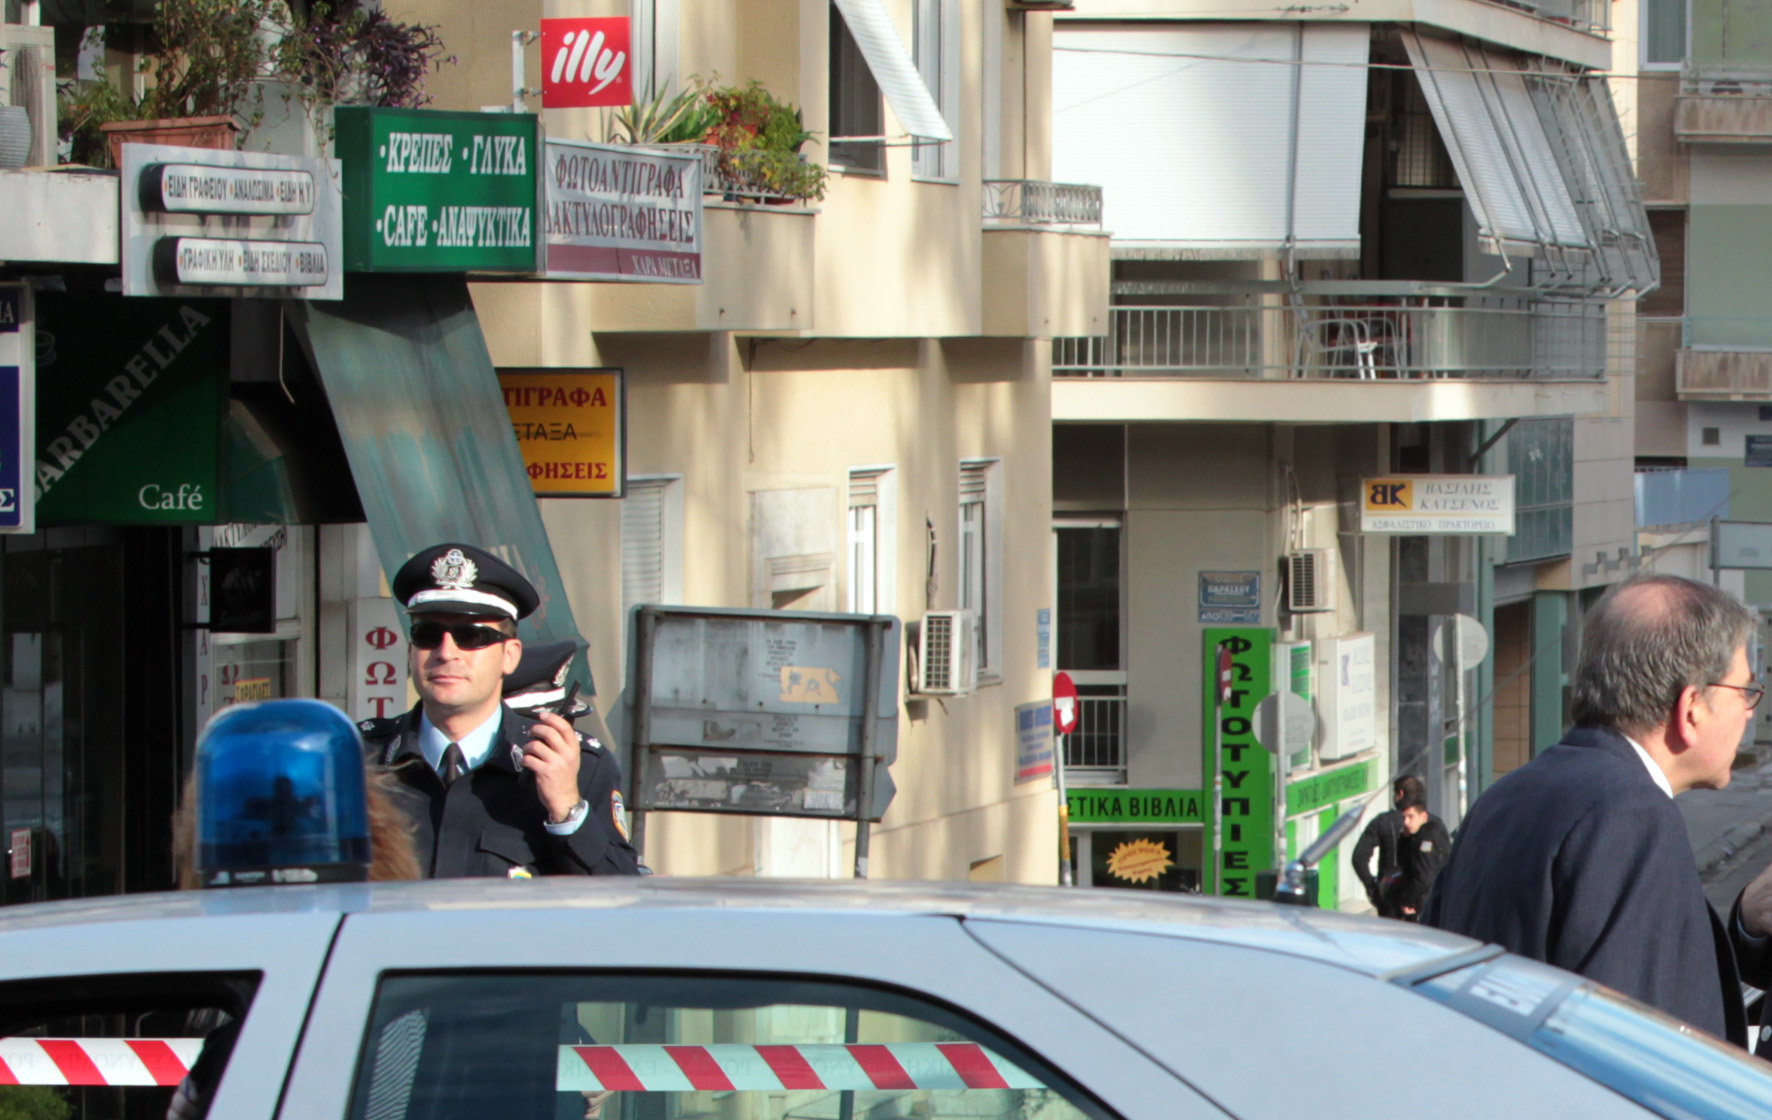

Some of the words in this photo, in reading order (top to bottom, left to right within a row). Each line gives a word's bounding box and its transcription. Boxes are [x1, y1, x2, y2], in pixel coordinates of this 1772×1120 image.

[551, 29, 626, 95] illy
[386, 132, 453, 173] ΚΡΕΠΕΣ
[470, 135, 527, 175] ΓΛΥΚΑ
[168, 175, 187, 199] ΕΙΔΗ
[189, 175, 227, 199] ΓΡΑΦΕΙΟΥ
[556, 153, 686, 199] ΦΩΤΟΑΝΤΙΓΡΑΦΑ
[383, 205, 428, 247] CAFE
[436, 206, 531, 247] ΑΝΑΨΥΚΤΙΚΑ
[183, 248, 217, 272] ΓΡΑΦΙΚΗ
[218, 248, 234, 272] ΥΛΗ
[300, 252, 325, 274] ΒΙΒΛΙΑ
[138, 484, 203, 510] Café
[1425, 483, 1492, 495] ΒΑΣΙΛΗΣ
[1420, 499, 1499, 510] ΚΑΤΣΕΝΟΣ
[1371, 520, 1432, 530] ΑΣΦΑΛΙΣΤΙΚΟ
[1438, 520, 1496, 530] ΠΡΑΚΤΟΡΕΙΟ
[1219, 636, 1252, 896] ΦΩΤΟΤΥΠΙΕΣ
[1129, 797, 1199, 817] ΒΙΒΛΙΑ
